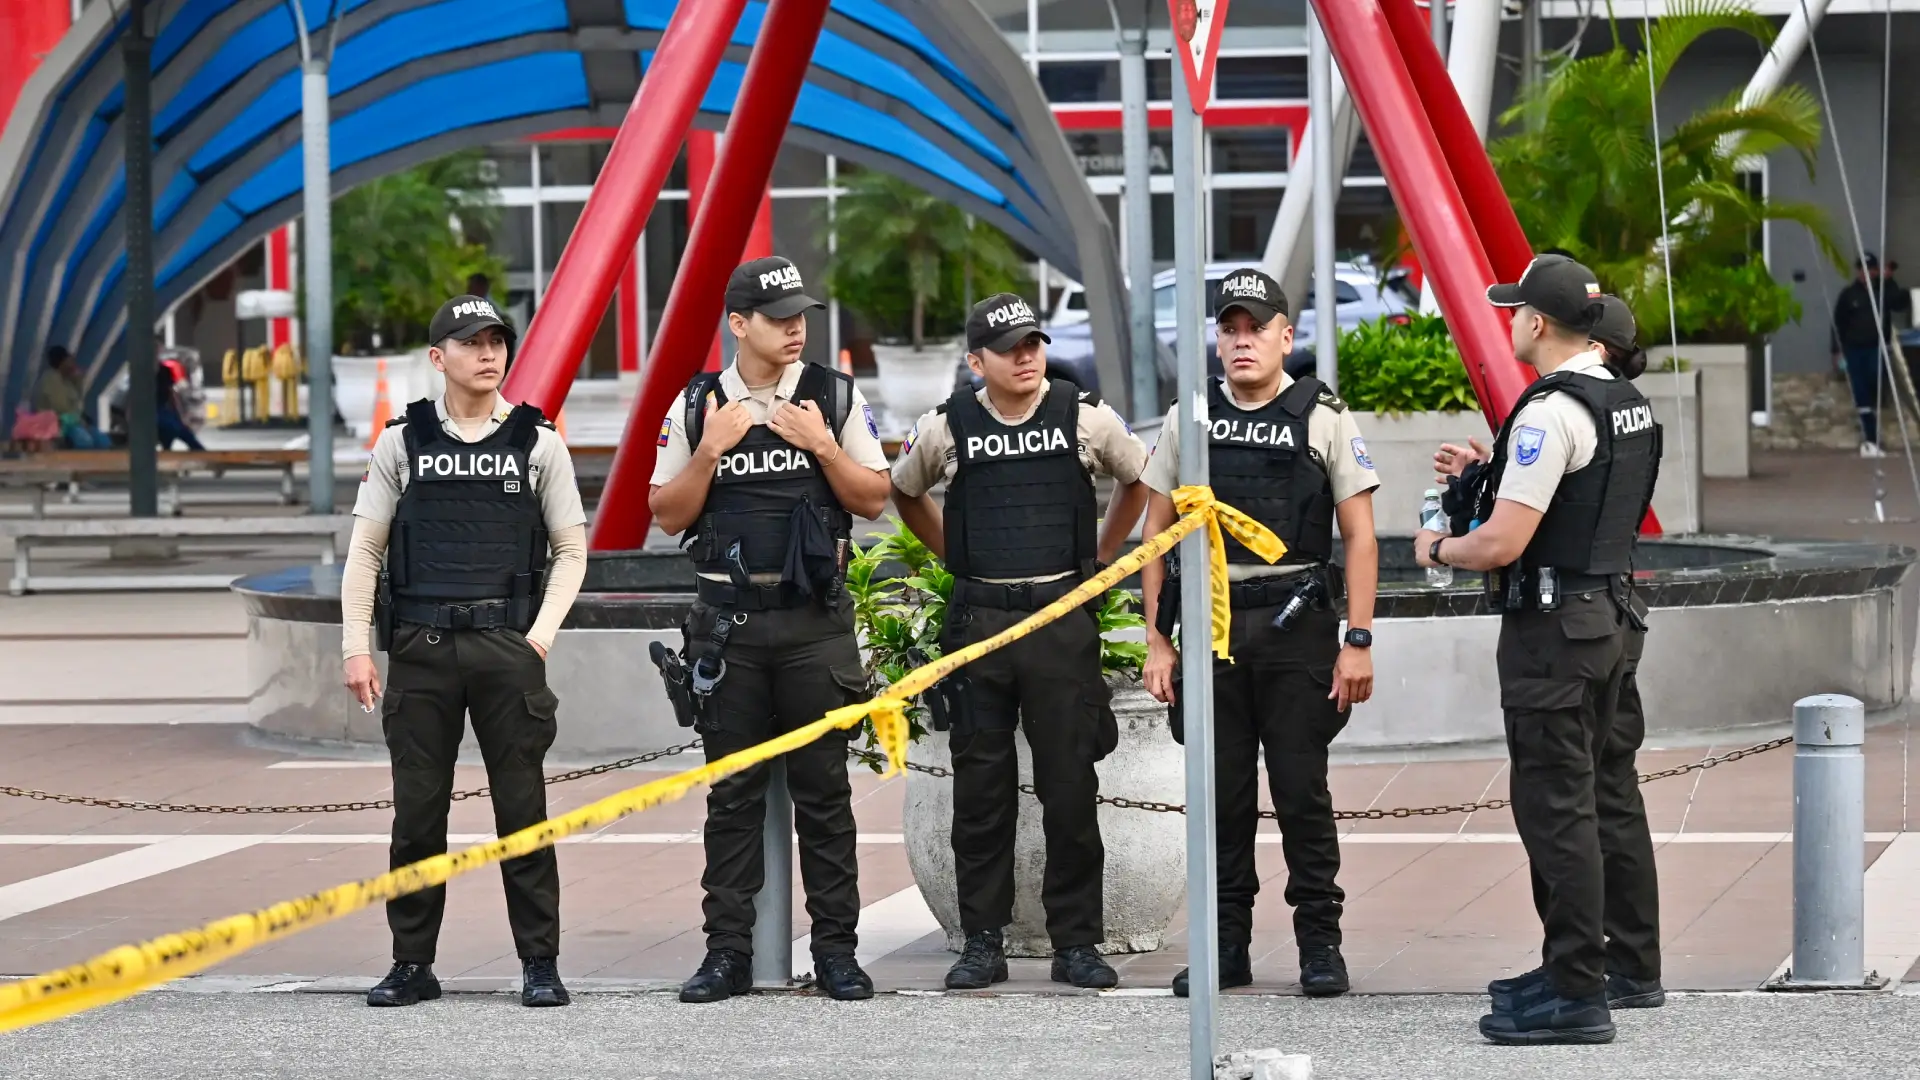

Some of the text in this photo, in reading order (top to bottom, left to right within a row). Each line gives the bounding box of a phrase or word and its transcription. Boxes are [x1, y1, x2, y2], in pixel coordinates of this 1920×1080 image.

[1233, 289, 1268, 301] NACIONAL
[1612, 404, 1653, 436] POLICIA
[967, 427, 1069, 459] POLICIA
[418, 453, 520, 477] POLICIA
[716, 449, 811, 477] POLICIA
